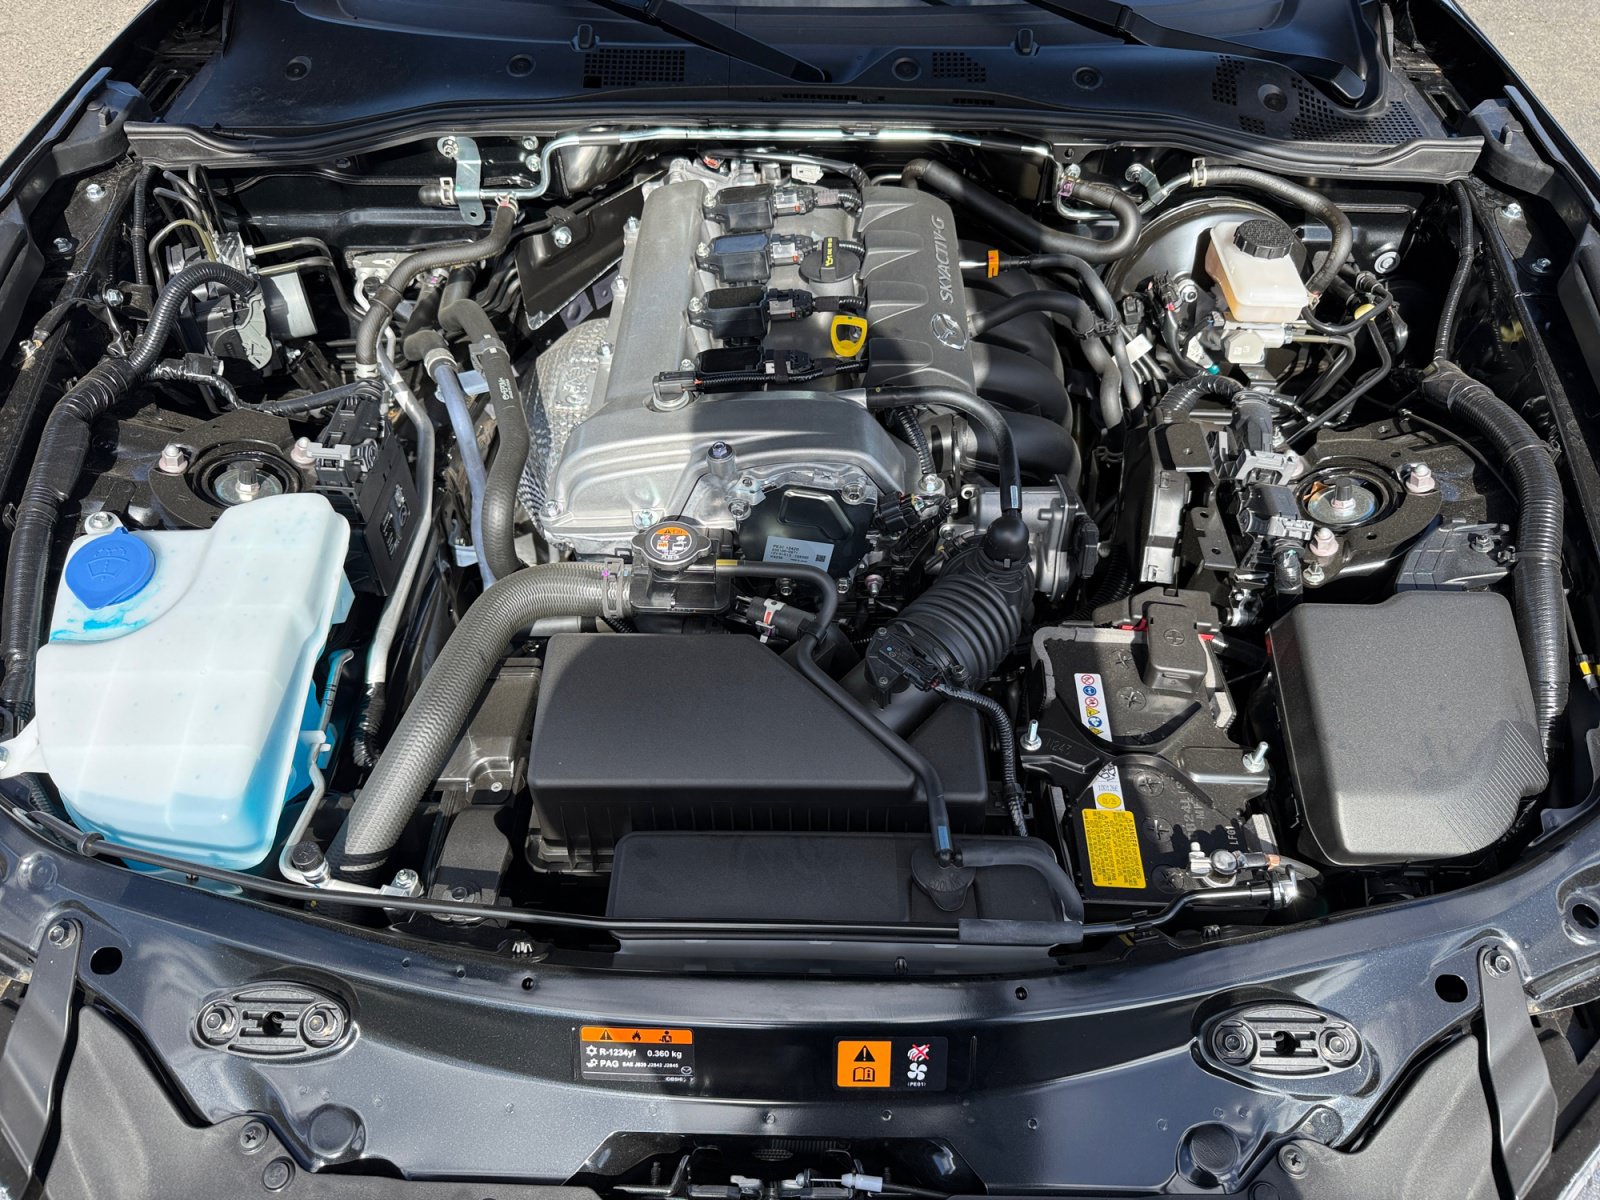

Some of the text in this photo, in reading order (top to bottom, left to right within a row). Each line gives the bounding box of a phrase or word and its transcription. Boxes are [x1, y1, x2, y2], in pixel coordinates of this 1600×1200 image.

[931, 215, 954, 304] SKYACTIV-G
[1128, 824, 1138, 847] DANGER
[599, 1048, 682, 1059] R-1234yf 0.360 kg
[600, 1060, 619, 1068] PAG
